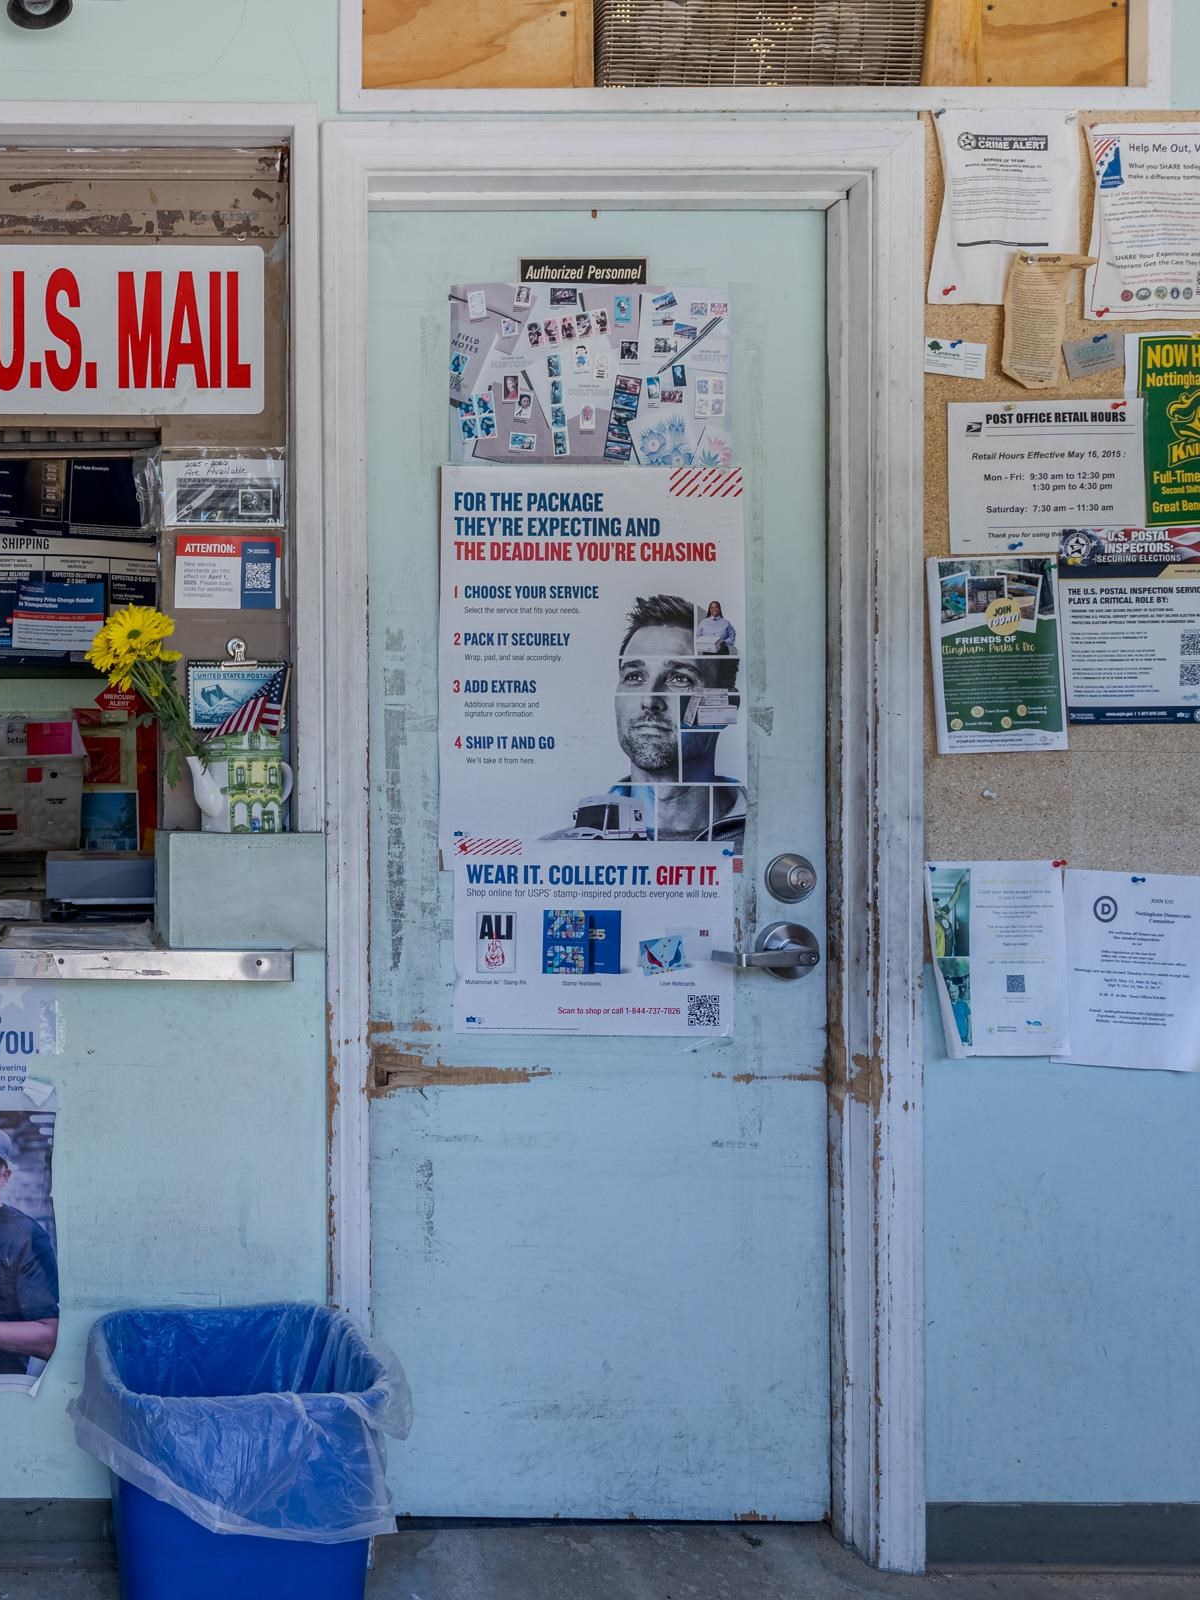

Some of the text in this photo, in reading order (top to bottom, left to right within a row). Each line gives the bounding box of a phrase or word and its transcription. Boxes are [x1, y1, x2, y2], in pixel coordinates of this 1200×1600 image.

[978, 141, 1046, 149] CRIME ALERT
[1129, 144, 1191, 154] Help Me Out,
[526, 265, 642, 281] Authorized Personnel
[117, 271, 252, 389] MAIL
[457, 332, 480, 346] FIELD
[451, 338, 479, 354] NOTES
[1147, 344, 1188, 369] NOW
[986, 411, 1126, 424] POST OFFICE RETAIL HOURS
[972, 450, 1121, 460] Retail Hours Effective May 16, 2015
[206, 467, 248, 476] Available
[984, 473, 1002, 481] Mon
[1010, 473, 1025, 481] Fri:
[1030, 472, 1048, 480] 9:30
[1102, 473, 1115, 481] pm
[454, 491, 604, 513] FOR THE PACKAGE
[454, 516, 660, 537] THEY'RE EXPECTING AND
[1107, 531, 1169, 542] U.S. POSTAL
[2, 538, 50, 550] SHIPPING
[185, 543, 236, 554] ATTENTION:
[1104, 543, 1174, 554] INSPECTORS:
[454, 541, 717, 562] THE DEADLINE YOU'RE CHASING
[1097, 554, 1181, 563] SECURING ELECTIONS
[454, 585, 600, 599] 1 CHOOSE YOUR SERVICE
[993, 605, 1012, 617] JOIN
[453, 632, 570, 646] 2 PACK IT SECURELY
[955, 635, 1017, 645] FRIENDS OF
[453, 680, 537, 694] 3 ADD EXTRAS
[103, 693, 135, 701] MERCURY
[454, 736, 555, 750] 4 SHIP IT AND GO
[466, 864, 720, 886] WEAR IT. COLLECT IT. GIFT IT.
[466, 888, 720, 900] Shop online for USPS stamp-inspired products everyone will love.
[479, 914, 513, 940] ALI
[558, 1006, 575, 1015] Scan
[576, 1007, 584, 1015] to
[585, 1007, 602, 1016] shop
[611, 1006, 624, 1015] call
[625, 1006, 681, 1015] 1-844-737-7826
